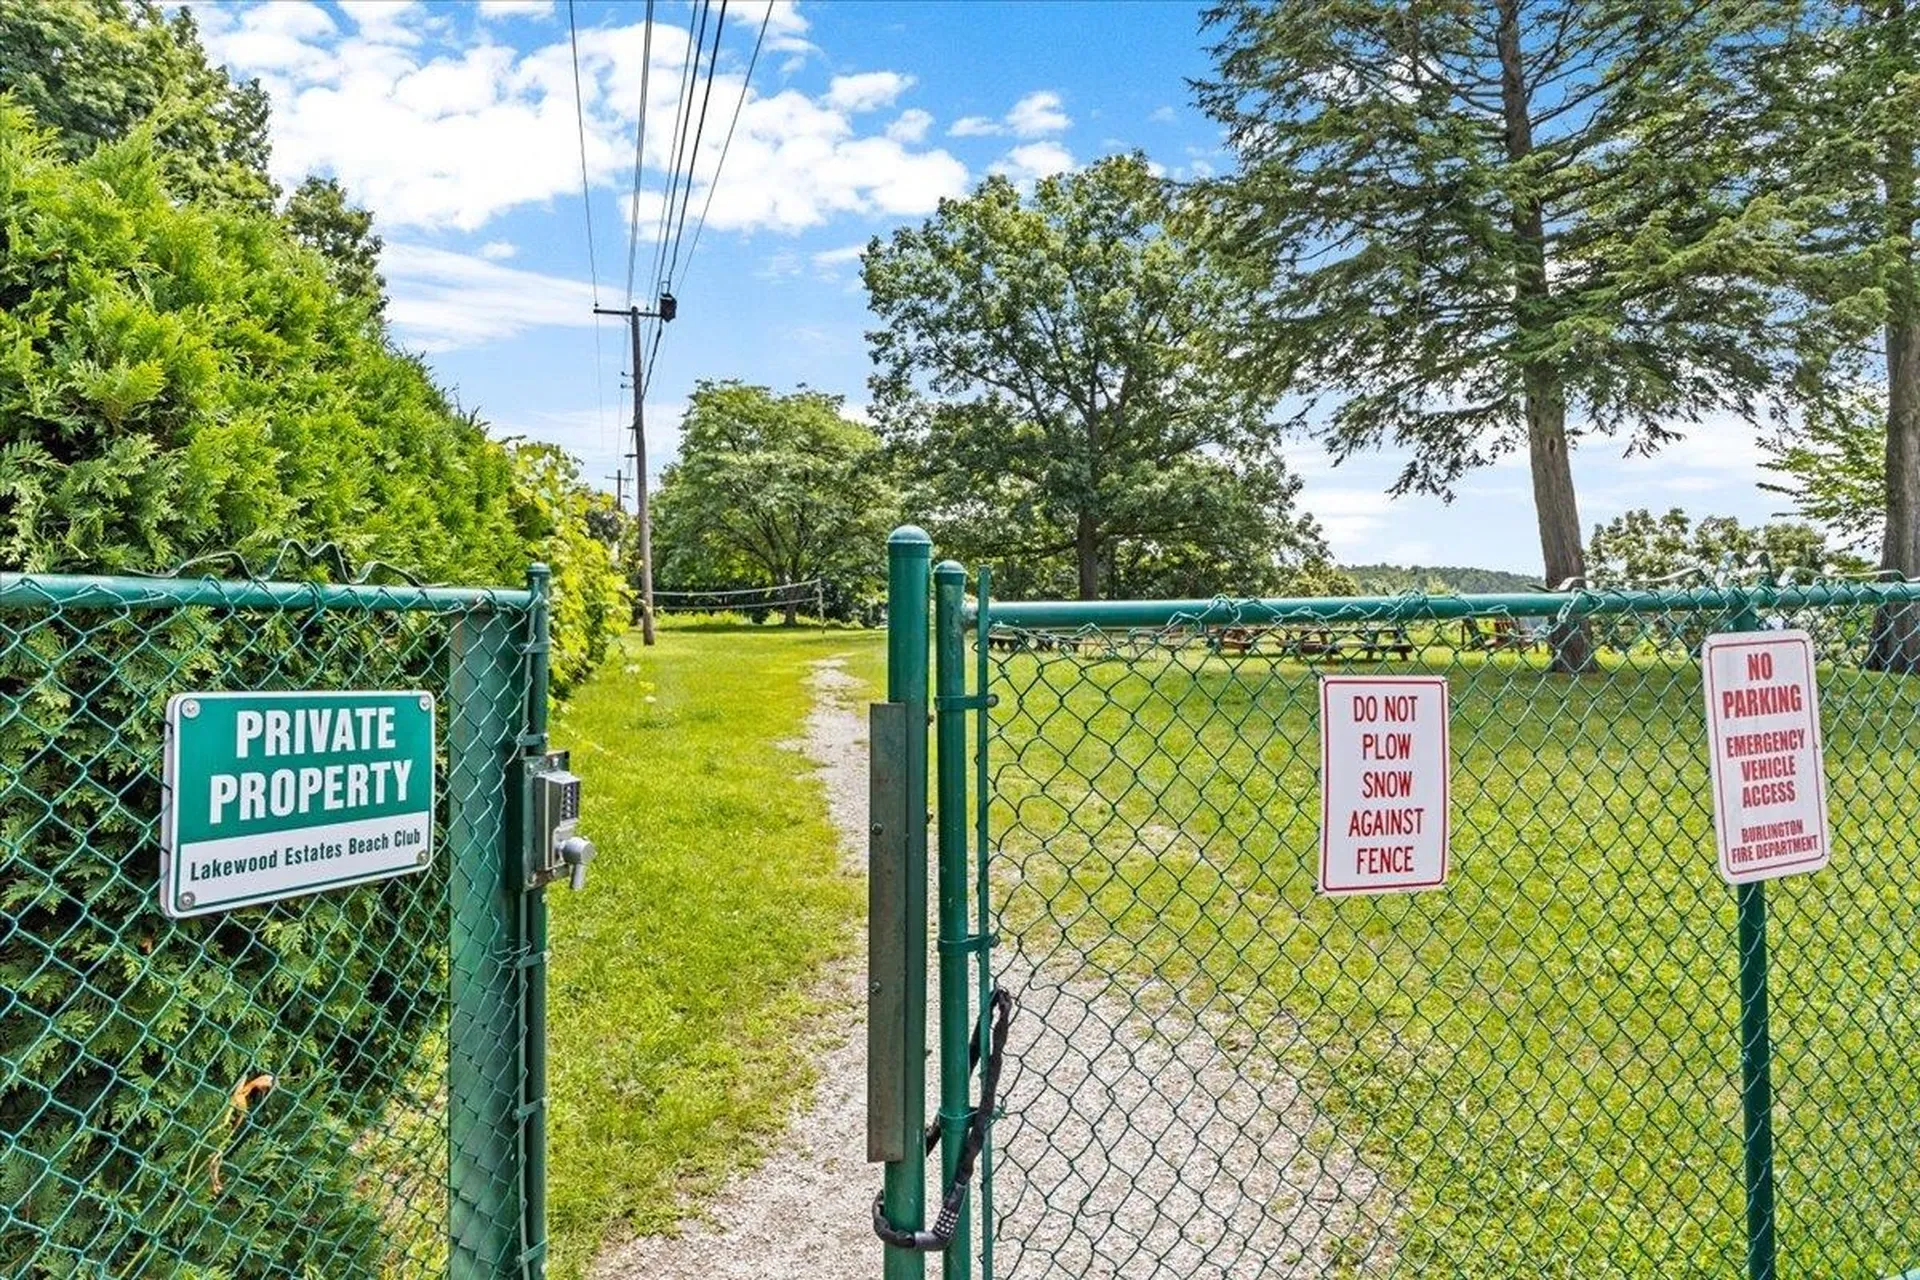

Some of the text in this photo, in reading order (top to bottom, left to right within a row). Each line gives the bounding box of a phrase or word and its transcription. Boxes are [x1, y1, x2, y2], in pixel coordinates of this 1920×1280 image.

[1747, 652, 1773, 681] NO
[1353, 696, 1418, 722] DO NOT
[1722, 684, 1802, 719] PARKING
[236, 707, 396, 759] PRIVATE
[1362, 733, 1411, 760] PLOW
[1726, 728, 1805, 758] EMERGENCY
[1741, 755, 1796, 783] VEHICLE
[209, 760, 412, 824] PROPERTY
[1362, 771, 1412, 798] SNOW
[1742, 781, 1796, 809] ACCESS
[1348, 808, 1424, 837] AGAINST
[1741, 820, 1804, 844] BURLINGTON
[190, 828, 421, 882] Lakewood Estates Beach Club
[1356, 846, 1414, 875] FENCE
[1731, 834, 1819, 864] FIRE DEPARTMENT
